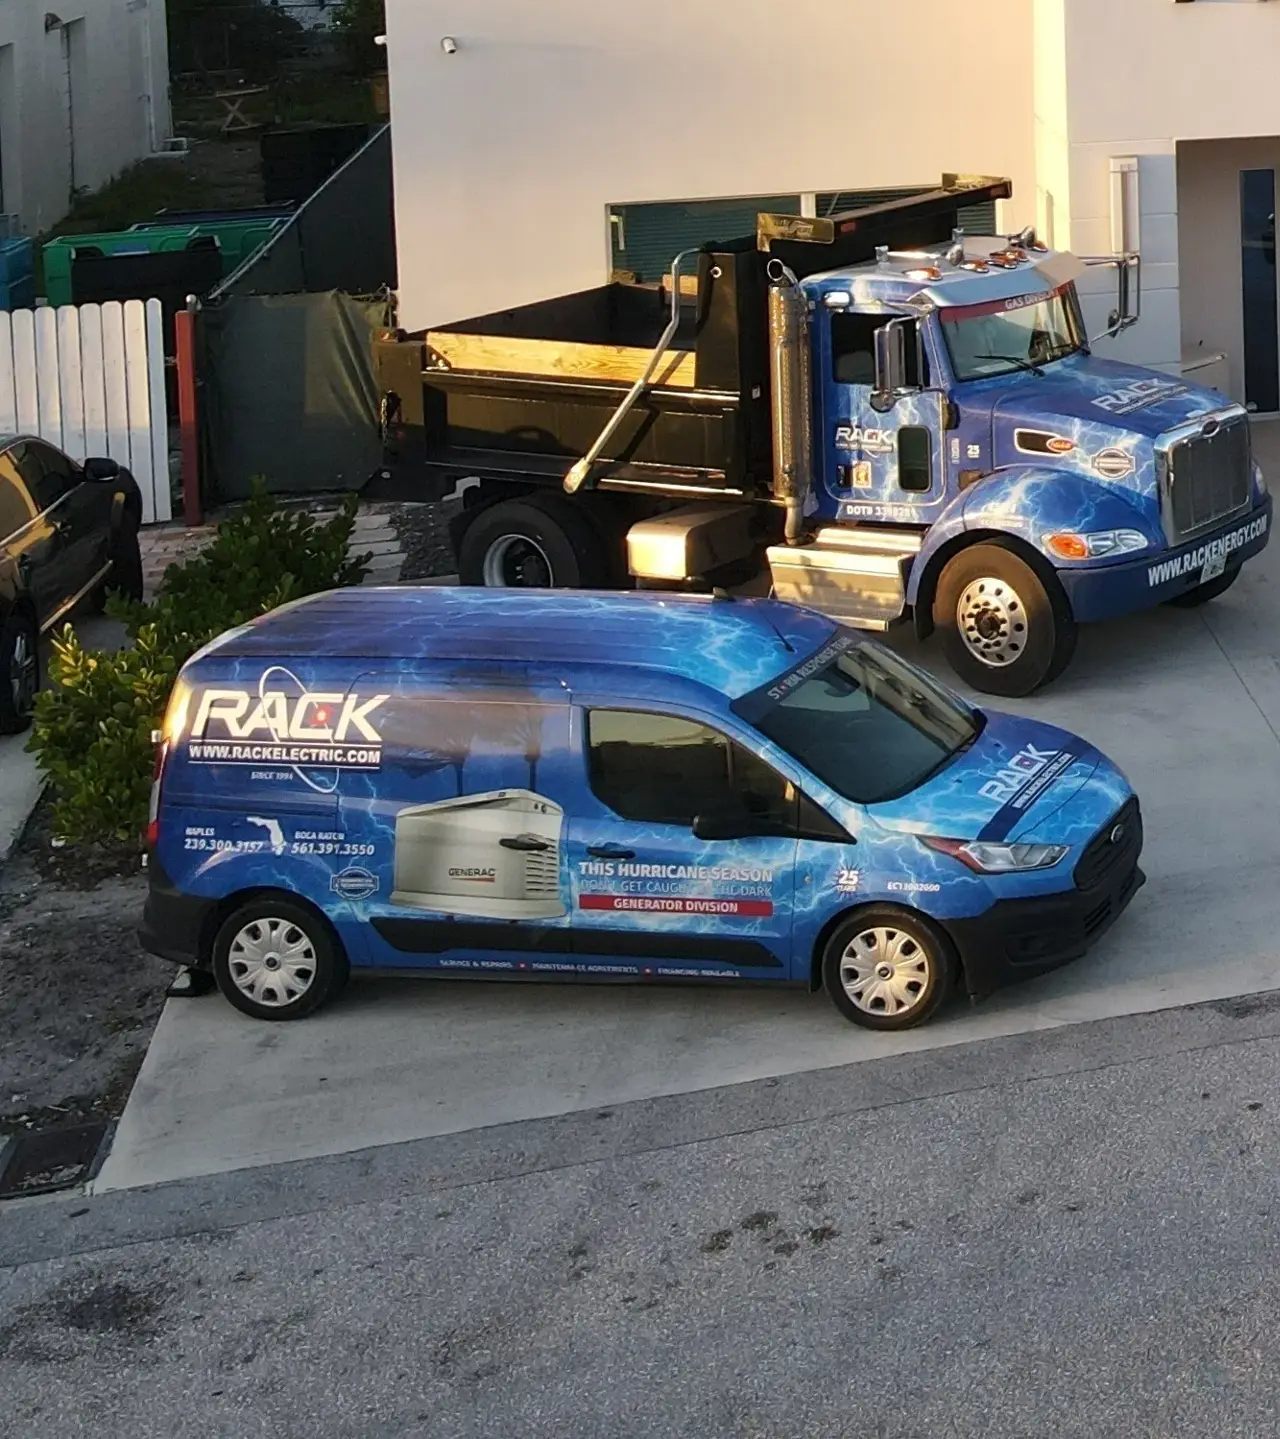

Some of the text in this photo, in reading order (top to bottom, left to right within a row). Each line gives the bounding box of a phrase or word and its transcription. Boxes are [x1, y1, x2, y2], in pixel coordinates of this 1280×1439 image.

[1090, 378, 1182, 411] RACK
[836, 427, 893, 443] RACK
[1147, 514, 1268, 587] WWW.RACKENERGY.COM
[191, 689, 391, 742] RACK
[189, 745, 381, 764] WWW.RACKELECTRIC.COM
[977, 743, 1060, 804] RACK
[291, 842, 375, 856] 561.391.3550
[448, 868, 496, 877] GENERAC
[579, 861, 774, 882] THIS HURRICANE SEASON
[838, 870, 859, 885] 25
[621, 880, 643, 892] GET
[739, 885, 773, 897] DARK
[613, 898, 738, 913] GENERATOR DIVISION
